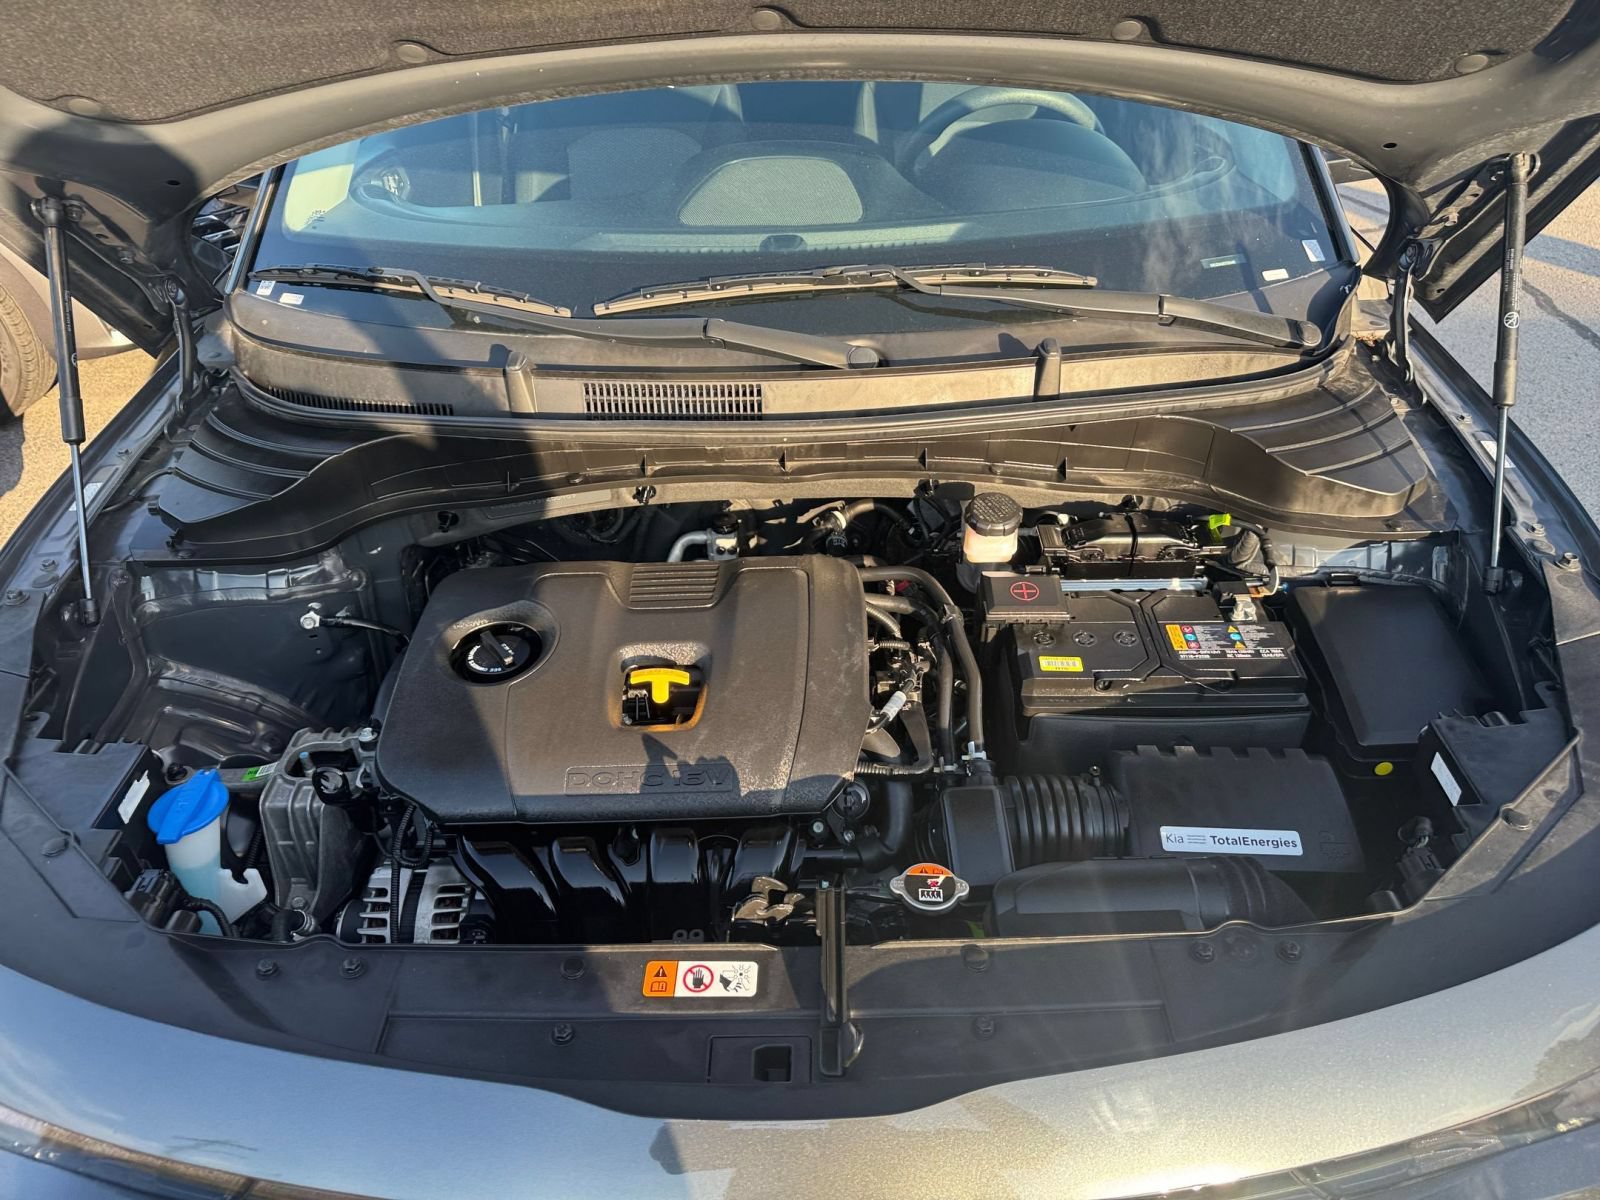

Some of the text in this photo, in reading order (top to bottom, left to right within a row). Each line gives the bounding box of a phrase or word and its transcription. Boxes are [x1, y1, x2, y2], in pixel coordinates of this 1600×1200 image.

[567, 772, 663, 787] DOHC
[1165, 833, 1184, 844] Kia
[1209, 835, 1298, 849] TotalEnergies
